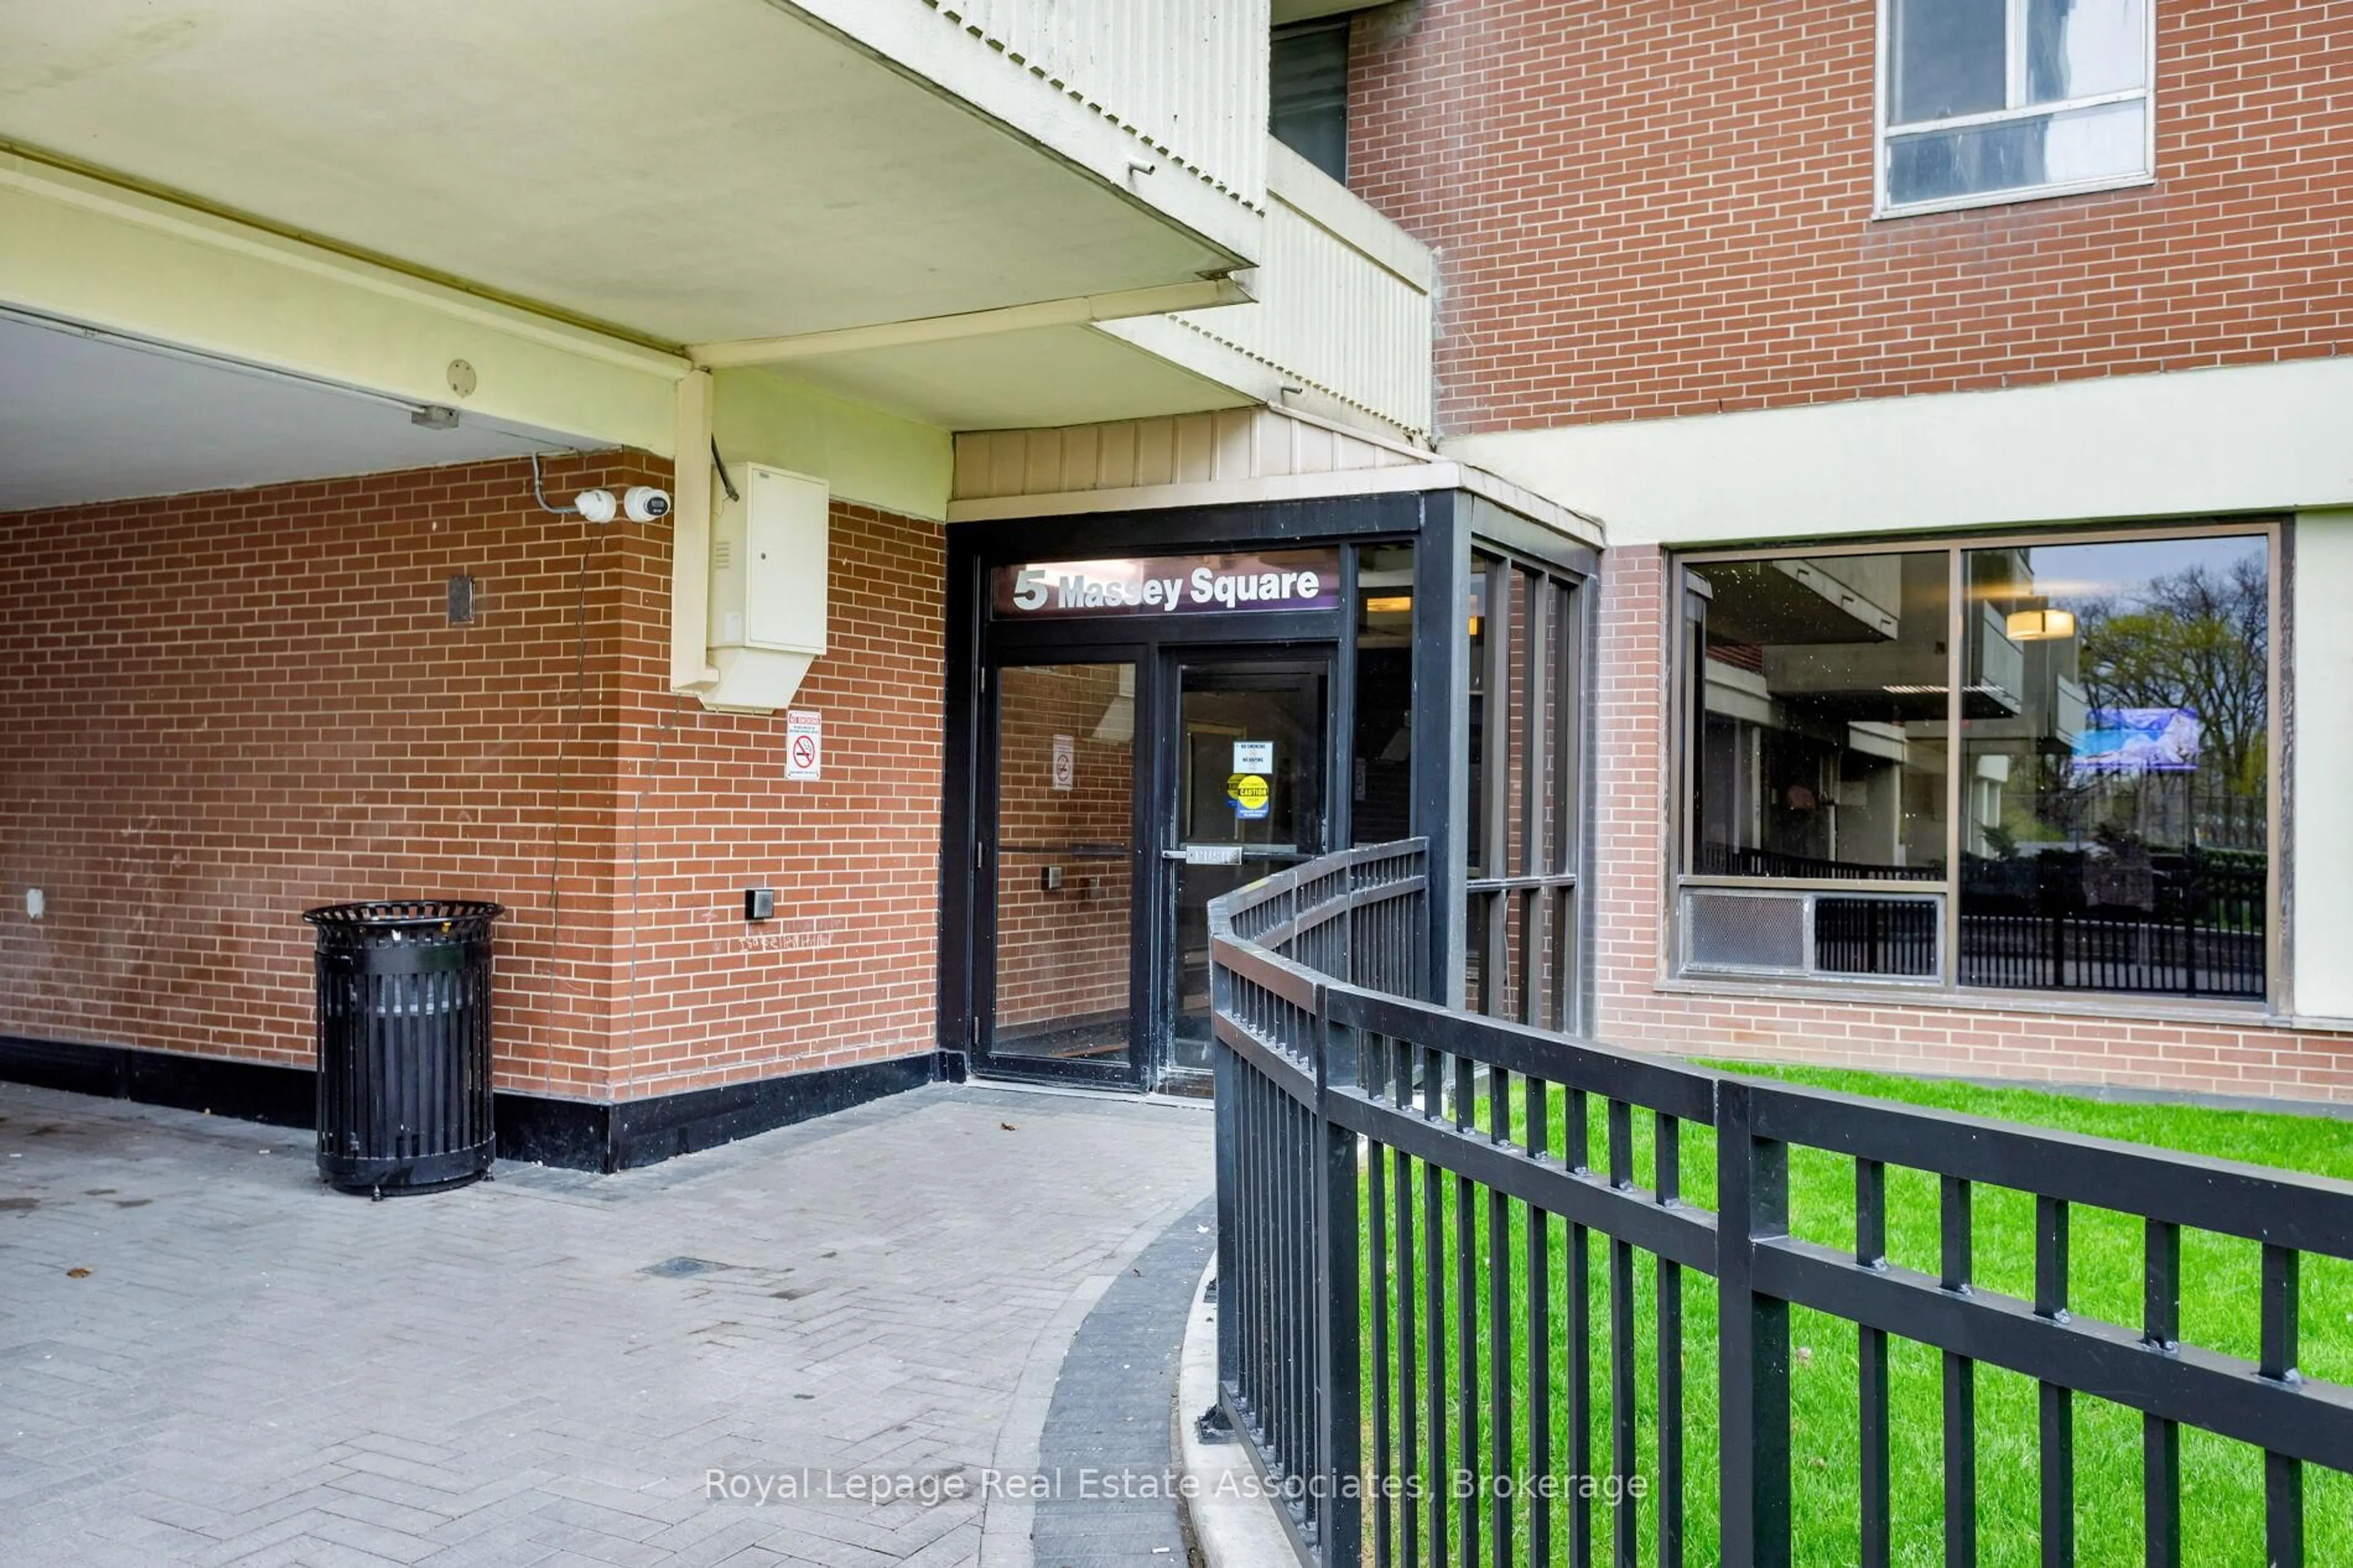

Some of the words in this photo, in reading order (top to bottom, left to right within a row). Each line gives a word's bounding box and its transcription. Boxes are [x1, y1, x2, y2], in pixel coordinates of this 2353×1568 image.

[1013, 570, 1048, 611] 5
[1058, 576, 1183, 612] Massey
[1191, 567, 1319, 608] Square
